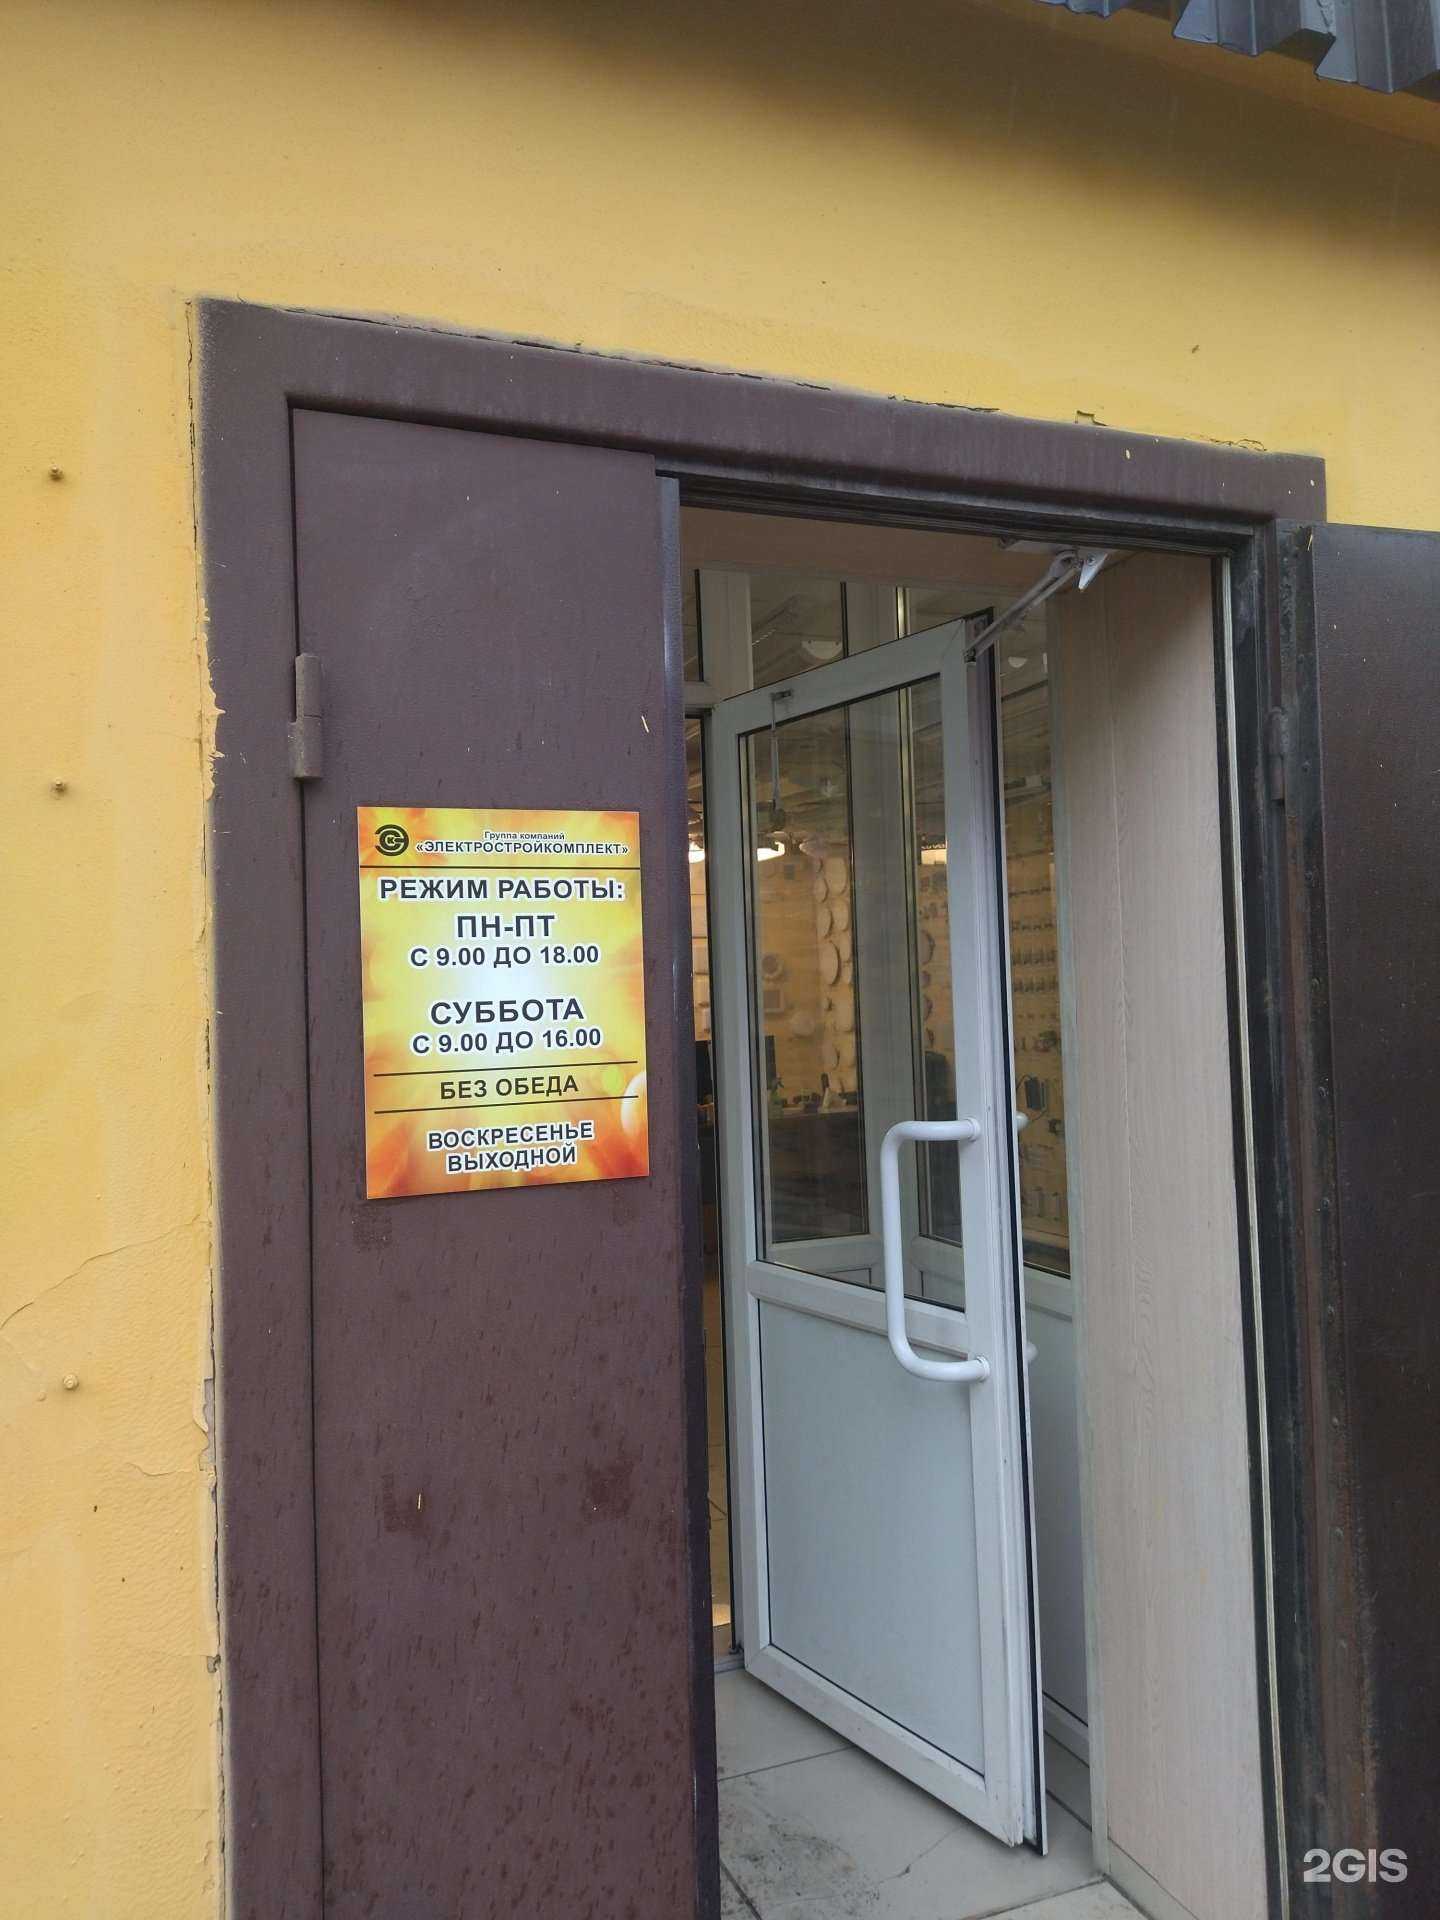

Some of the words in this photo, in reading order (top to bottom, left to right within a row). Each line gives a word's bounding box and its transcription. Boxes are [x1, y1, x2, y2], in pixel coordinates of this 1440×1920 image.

[416, 840, 628, 854] «ЭЛЕКТРОСТРОЙКОМПЛЕКТ»
[484, 831, 518, 841] Группа
[520, 831, 565, 840] компаний
[380, 880, 488, 899] РЕЖИМ
[498, 879, 623, 898] РАБОТЫ:
[457, 915, 555, 938] ПН-ПТ
[410, 948, 427, 966] С
[436, 947, 485, 965] 9.00
[494, 947, 531, 968] ДО
[540, 946, 598, 964] 18.00
[430, 998, 584, 1025] СУББОТА
[412, 1035, 429, 1053] С
[438, 1034, 487, 1052] 9.00
[496, 1032, 533, 1053] ДО
[543, 1029, 601, 1048] 16.00
[440, 1079, 487, 1099] БЕЗ
[495, 1075, 579, 1097] ОБЕДА
[429, 1122, 593, 1149] ВОСКРЕСЕНЬЕ
[448, 1142, 576, 1172] ВЫХОДНОЙ
